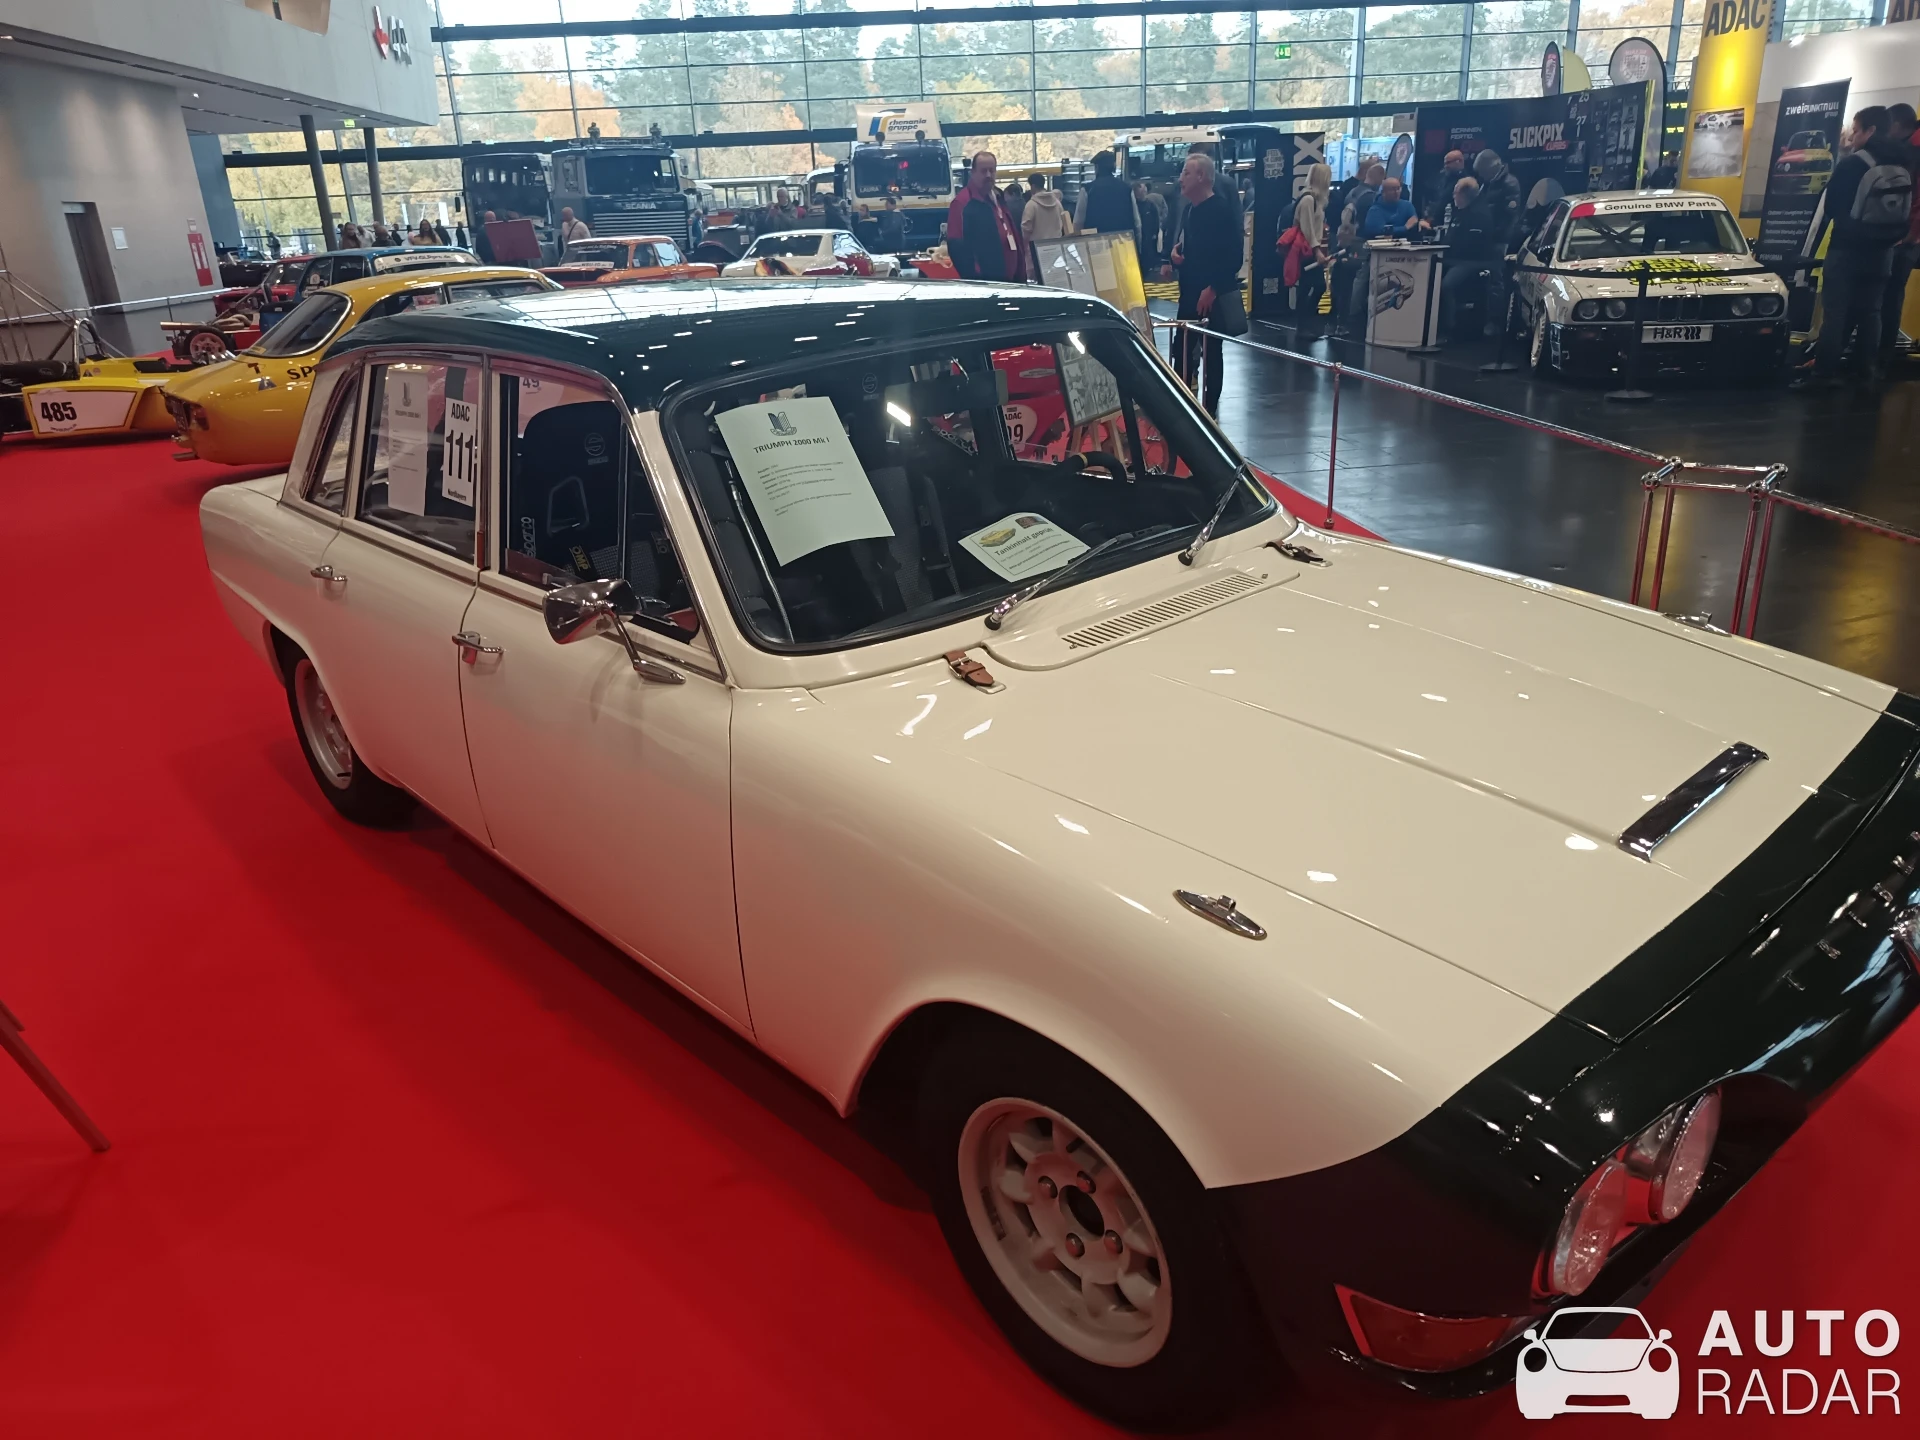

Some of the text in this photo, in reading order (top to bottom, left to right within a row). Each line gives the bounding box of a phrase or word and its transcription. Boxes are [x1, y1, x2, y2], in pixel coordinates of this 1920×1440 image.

[1704, 0, 1767, 38] ADAC
[889, 118, 927, 126] rhenania
[1154, 136, 1183, 144] V10
[1507, 122, 1565, 149] SLICKPIX
[625, 202, 657, 210] SCANIA
[1604, 200, 1717, 211] Genuine BMW Parts
[1653, 327, 1683, 340] H&R
[287, 365, 317, 380] SP
[41, 401, 78, 422] 485
[450, 402, 470, 422] ADAC
[753, 440, 793, 454] TRIUMPH
[794, 438, 812, 446] 2000
[445, 429, 474, 483] 111
[994, 535, 1030, 556] Tankinhalt
[570, 545, 592, 571] OMP
